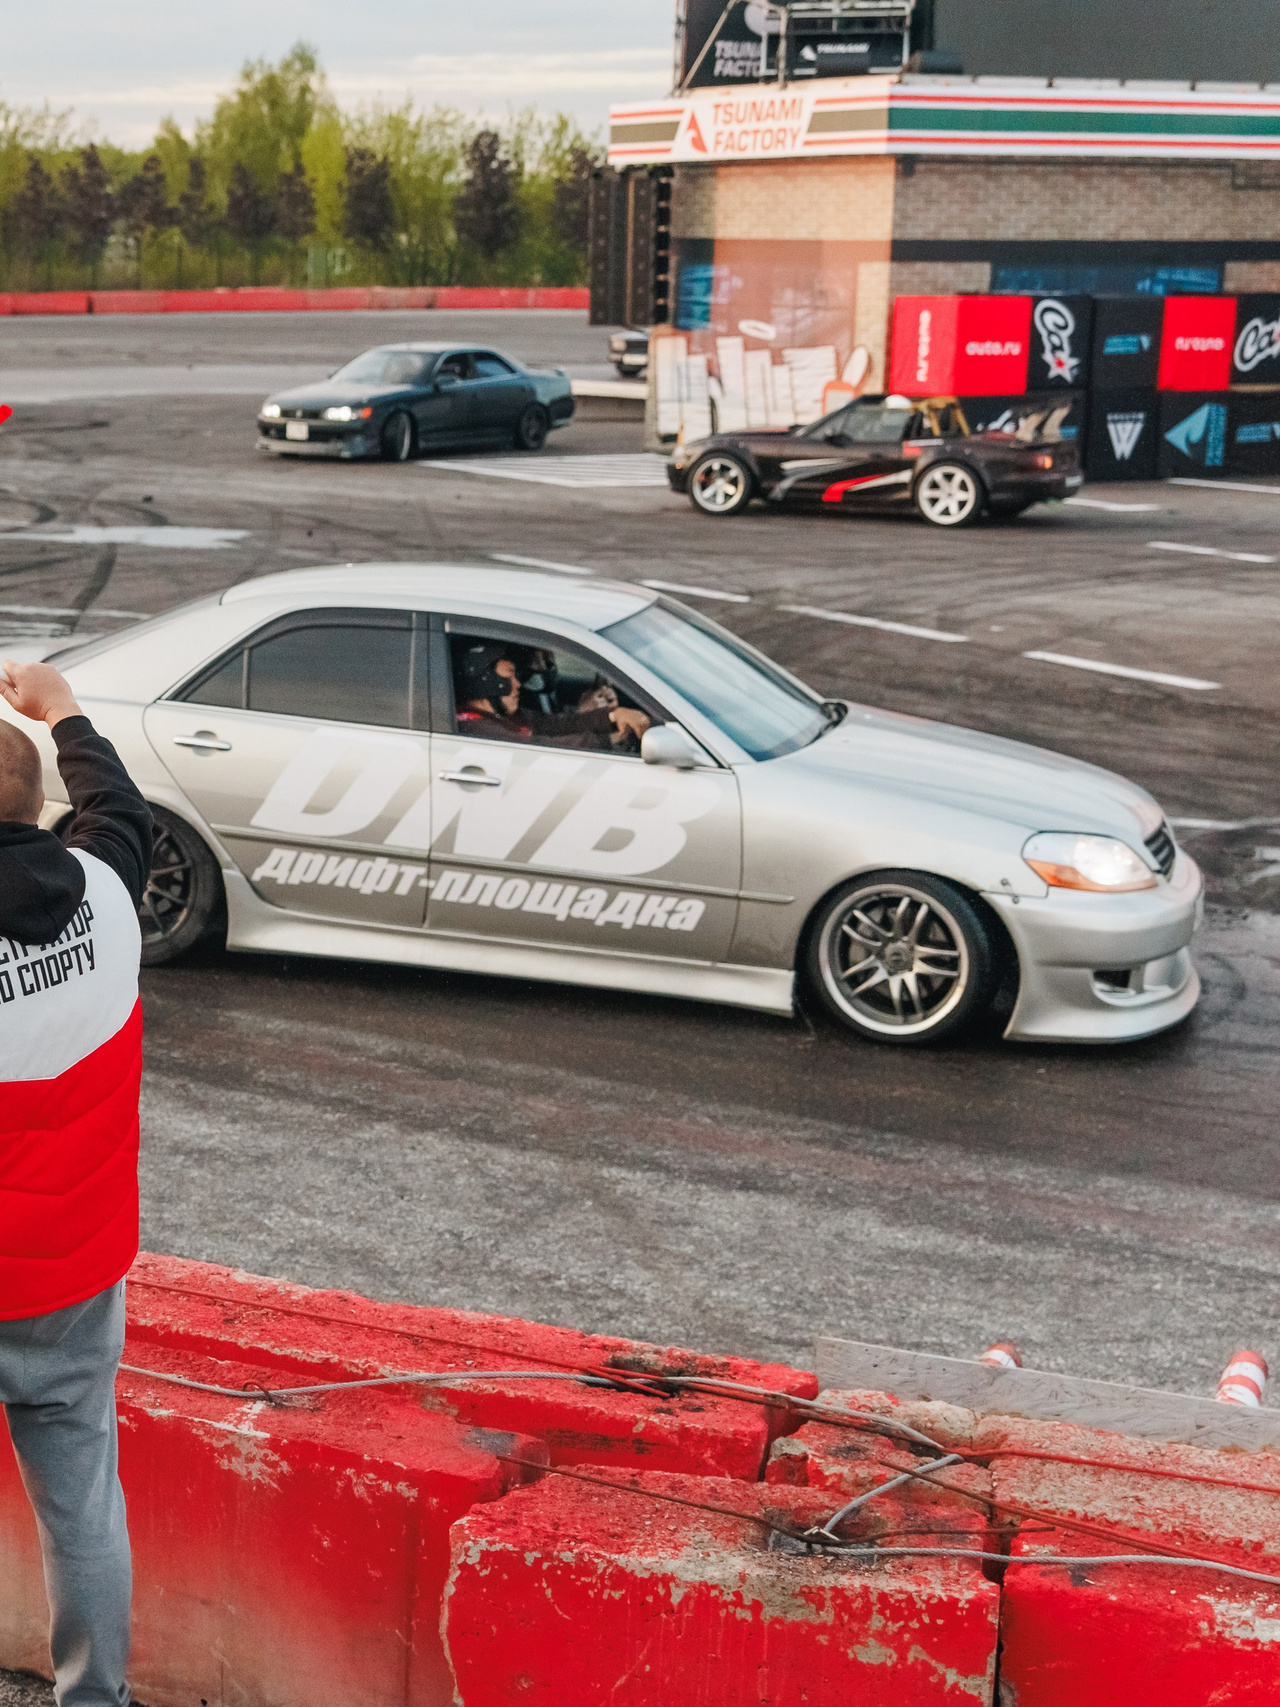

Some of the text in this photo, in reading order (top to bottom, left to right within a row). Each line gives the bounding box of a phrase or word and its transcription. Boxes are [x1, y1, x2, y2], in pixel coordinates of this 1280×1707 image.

[713, 98, 803, 124] TSUNAMI
[713, 126, 802, 153] FACTORY
[965, 341, 1021, 356] auto.ru
[249, 726, 718, 876] DNB
[252, 848, 707, 932] дрифт-площадка
[17, 938, 95, 996] СПОРТУ
